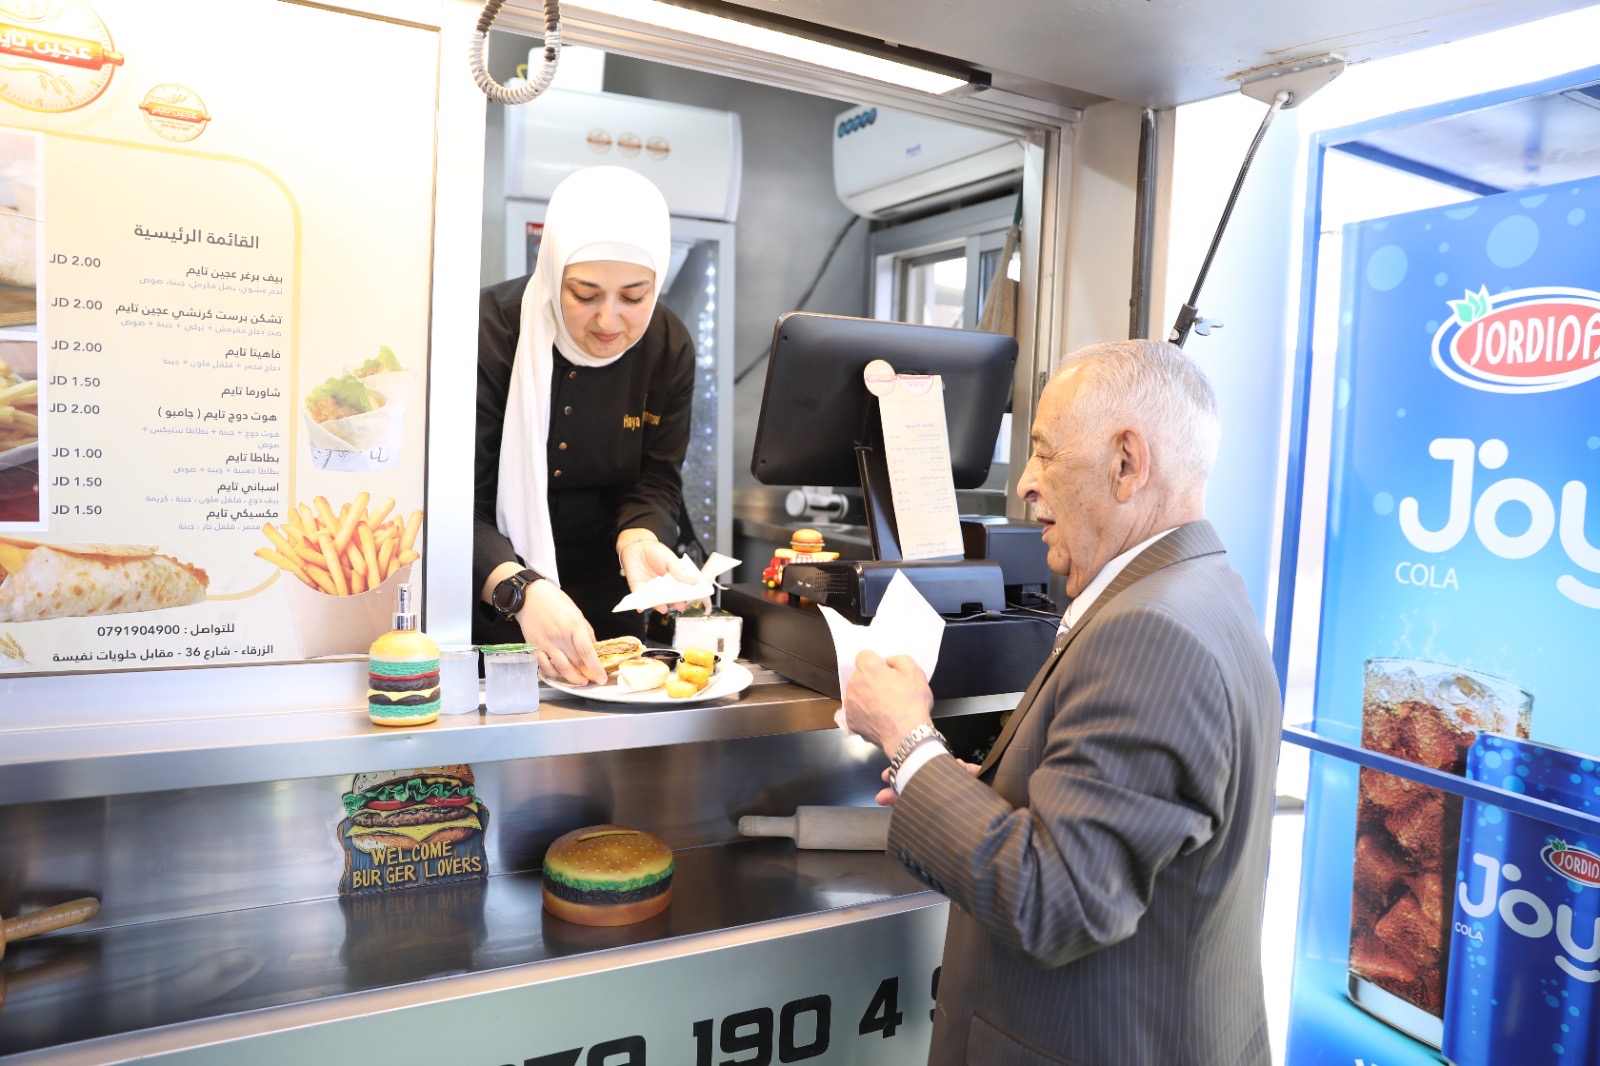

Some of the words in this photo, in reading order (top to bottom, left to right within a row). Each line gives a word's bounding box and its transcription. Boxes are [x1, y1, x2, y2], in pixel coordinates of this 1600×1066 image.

[0, 29, 27, 48] تاي
[33, 40, 93, 60] عجين
[134, 224, 202, 244] الرئيسية
[206, 231, 259, 249] القائمة
[50, 254, 68, 264] JD
[72, 255, 101, 268] 2.00
[186, 266, 208, 277] تايم
[211, 269, 237, 279] عجين
[240, 272, 259, 282] برغر
[262, 274, 283, 285] بيف
[51, 297, 69, 308] JD
[73, 299, 103, 311] 2.00
[115, 302, 138, 314] تايم
[141, 306, 168, 316] عجين
[172, 307, 212, 320] كرنشي
[216, 311, 247, 323] برست
[250, 313, 282, 325] تشكن
[51, 340, 69, 351] JD
[73, 341, 102, 353] 2.00
[225, 347, 247, 359] تايم
[250, 348, 281, 360] فاهيتا
[49, 376, 68, 386] JD
[71, 376, 101, 388] 1.50
[221, 386, 242, 398] تايم
[246, 387, 280, 398] شاورما
[49, 403, 68, 414] JD
[71, 404, 100, 415] 2.00
[165, 408, 194, 419] جامبو
[204, 409, 226, 421] تايم
[228, 413, 248, 423] دوج
[251, 412, 277, 423] هوت
[623, 414, 641, 431] Haya
[51, 448, 70, 458] JD
[74, 448, 102, 459] 1.00
[225, 452, 247, 464] تايم
[250, 453, 279, 464] بطاطا
[52, 476, 70, 487] JD
[74, 476, 102, 487] 1.50
[217, 481, 238, 494] تايم
[241, 482, 279, 494] اسباني
[52, 505, 70, 515] JD
[74, 505, 102, 515] 1.50
[206, 508, 228, 521] تايم
[230, 509, 279, 522] مكسيكي
[1395, 561, 1459, 591] COLA
[97, 624, 180, 637] 0791904900
[190, 624, 235, 636] للتواصل
[96, 650, 136, 661] حلويات
[140, 650, 174, 661] مقابل
[185, 647, 201, 657] 36
[203, 646, 231, 660] شارع
[241, 645, 274, 656] الزرقاء
[52, 652, 93, 663] نفيسة
[371, 840, 453, 866] WELCOME
[424, 856, 482, 878] LOVERS
[1558, 852, 1600, 879] JORDIN
[1454, 922, 1483, 942] COLA
[693, 994, 831, 1066] 190
